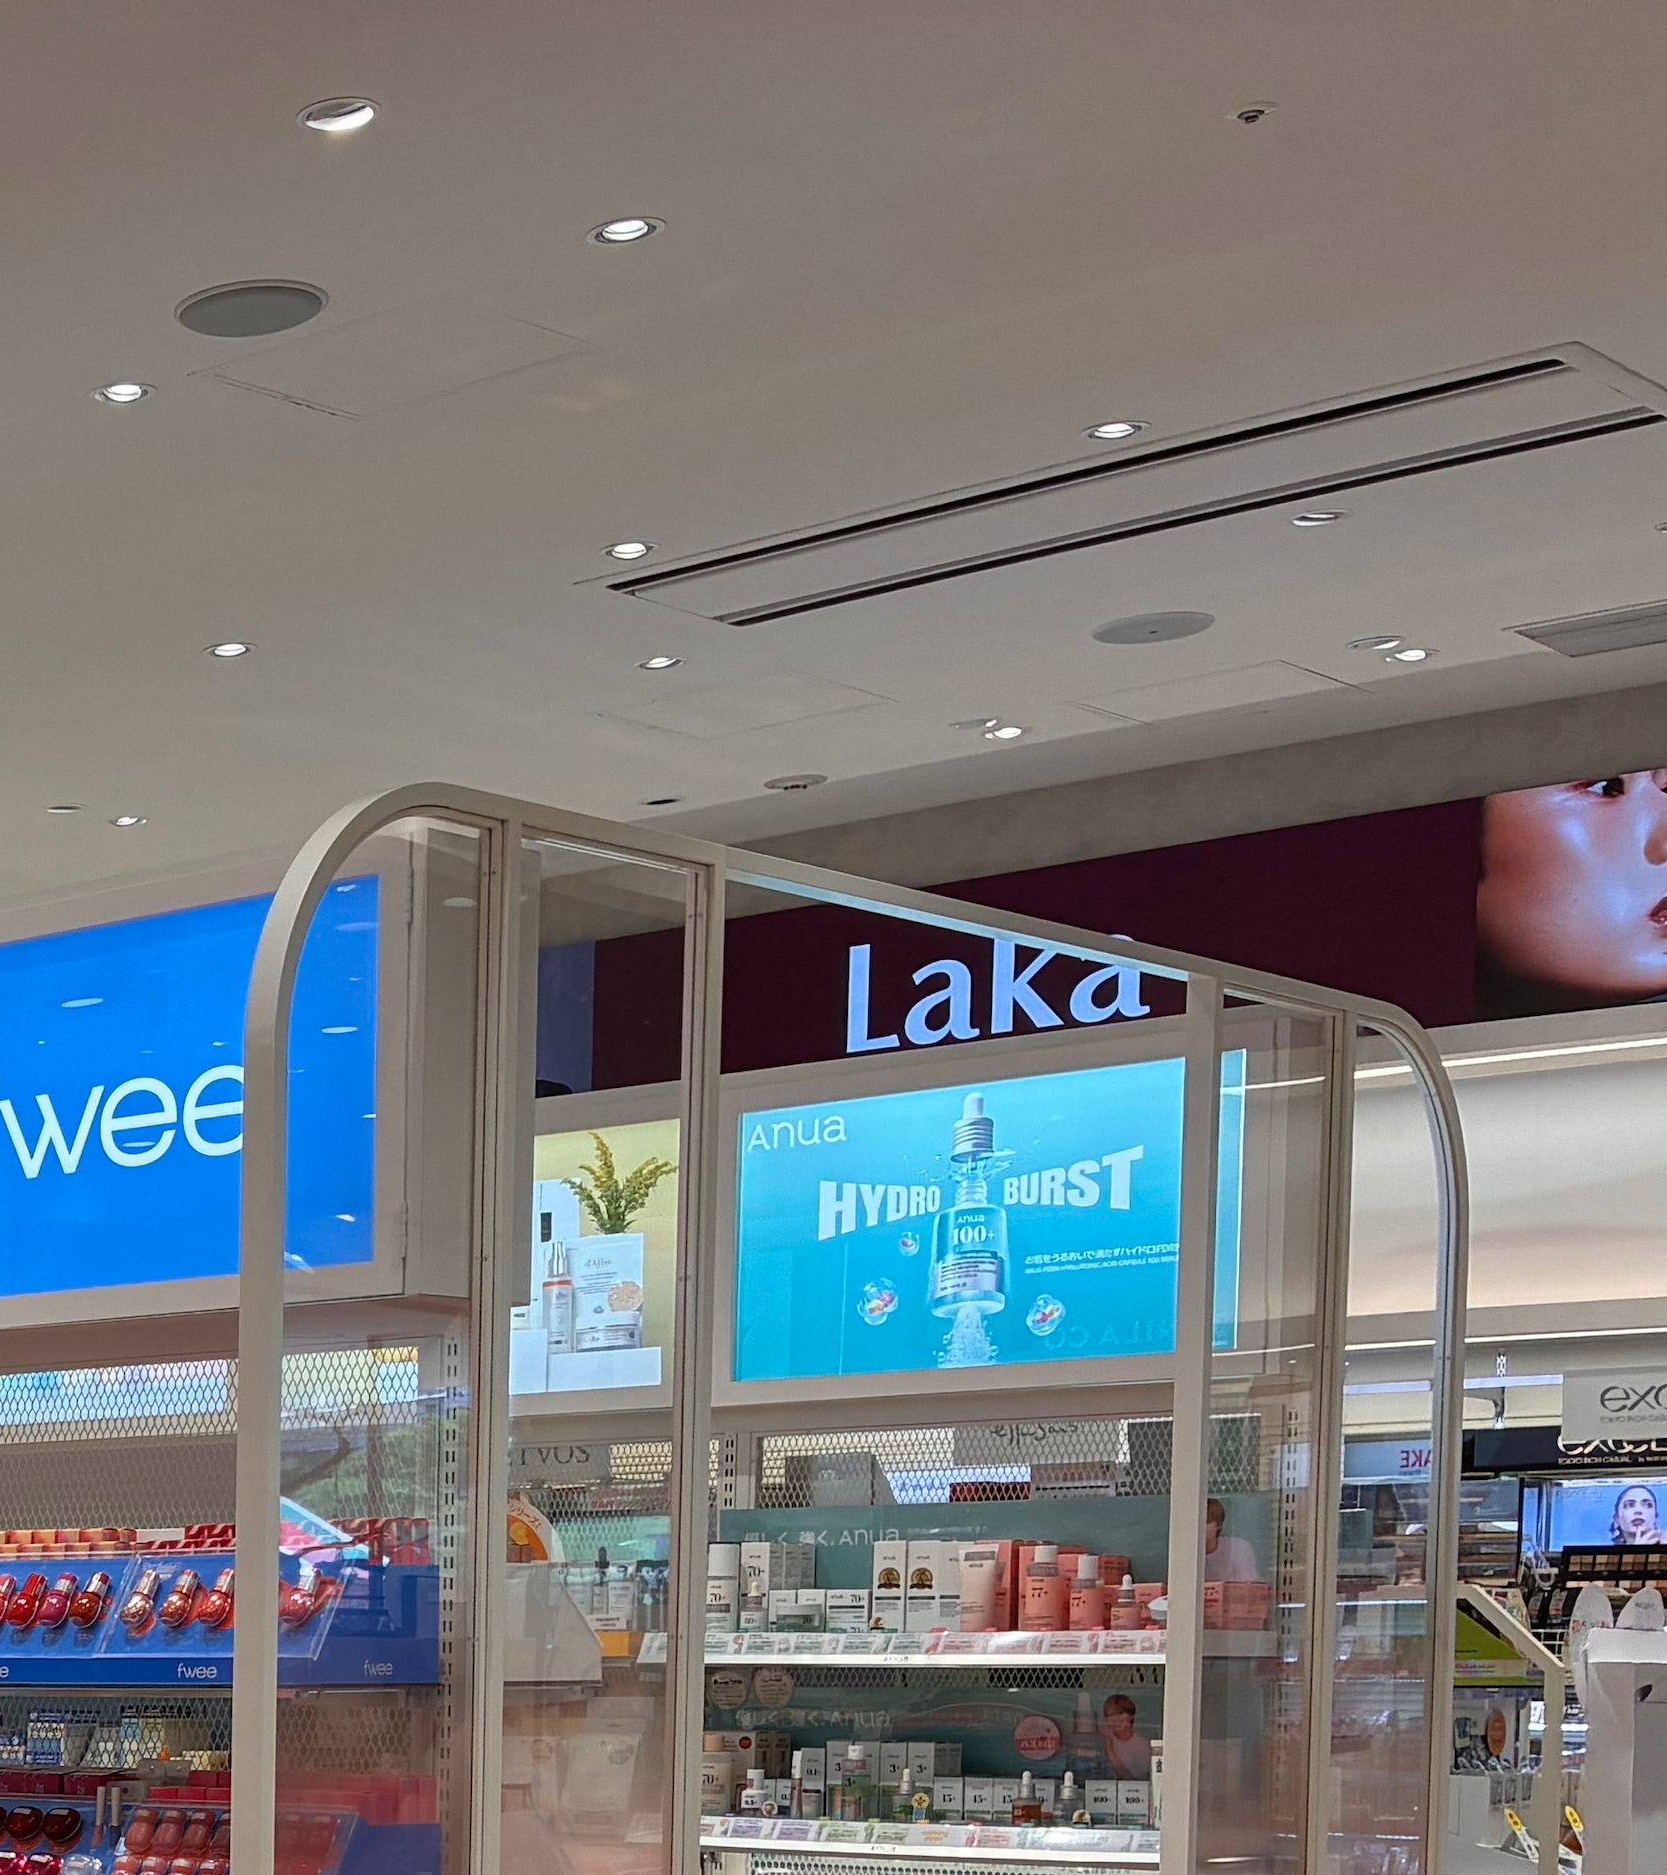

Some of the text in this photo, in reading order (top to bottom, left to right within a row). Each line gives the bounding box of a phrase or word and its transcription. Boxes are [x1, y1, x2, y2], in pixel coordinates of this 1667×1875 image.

[847, 934, 1151, 1054] Laka
[747, 1114, 846, 1153] Anua
[818, 1145, 1143, 1241] HYDRO BURST
[840, 1527, 899, 1546] Anua
[177, 1662, 217, 1680] fwee
[364, 1660, 393, 1676] fwee
